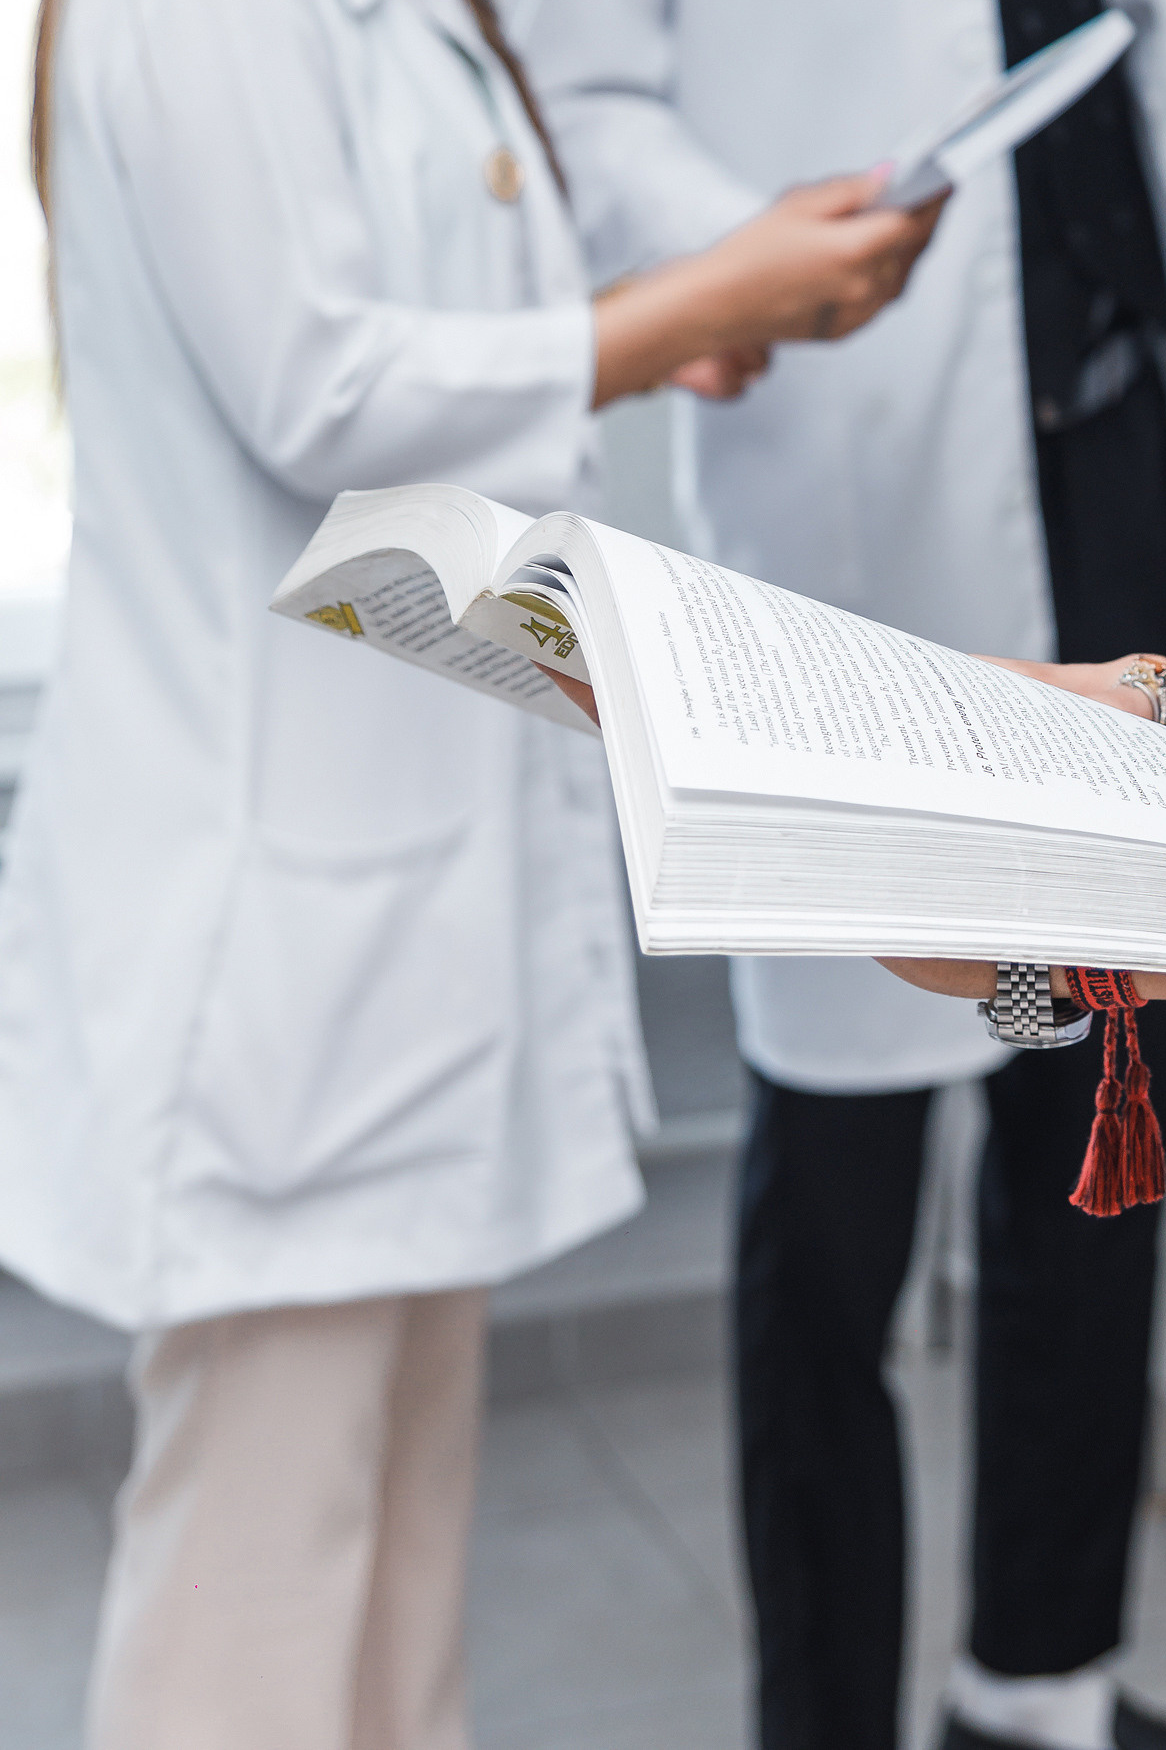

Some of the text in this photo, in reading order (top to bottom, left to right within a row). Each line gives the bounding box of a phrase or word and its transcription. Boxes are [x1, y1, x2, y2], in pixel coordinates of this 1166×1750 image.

[676, 586, 689, 603] from
[694, 595, 704, 606] the
[658, 611, 672, 638] Medicine
[683, 604, 700, 634] suffering
[742, 615, 754, 628] that
[701, 616, 720, 642] present
[732, 619, 745, 640] occurs
[696, 636, 712, 664] persons
[748, 629, 766, 657] anaemia
[666, 639, 684, 677] Community
[728, 648, 738, 661] the
[739, 640, 757, 672] normally
[788, 642, 807, 665] picture
[816, 646, 832, 667] motor
[830, 652, 845, 667] cord
[704, 666, 713, 674] in
[716, 658, 730, 687] vitamin
[733, 663, 741, 671] in
[810, 662, 822, 672] by
[849, 659, 868, 683] picture
[878, 656, 895, 674] given
[676, 678, 686, 686] of
[708, 676, 718, 693] seen
[737, 673, 747, 690] seen
[750, 673, 761, 688] that
[795, 664, 813, 689] clinical
[815, 673, 826, 687] acts
[838, 668, 857, 689] spinal
[725, 689, 735, 701] the
[806, 689, 818, 703] The
[849, 689, 860, 701] the
[891, 680, 904, 695] dose
[680, 688, 696, 719] Principles
[712, 695, 723, 711] also
[728, 703, 739, 713] all
[782, 680, 805, 720] pernicious
[852, 701, 864, 711] of
[885, 694, 901, 720] Vitamin
[899, 696, 913, 714] same
[928, 689, 946, 714] nursing
[746, 709, 760, 731] Lastly
[907, 715, 919, 727] the
[941, 715, 952, 726] are
[952, 698, 972, 726] energy
[733, 715, 749, 745] absorbs
[793, 721, 809, 744] called
[813, 705, 835, 755] Recognition.
[845, 715, 861, 743] sensory
[859, 713, 882, 761] degeneration
[947, 727, 959, 742] who
[1008, 725, 1022, 741] They
[785, 741, 797, 751] of
[880, 733, 892, 748] The
[898, 724, 919, 765] Treatment.
[967, 728, 988, 760] Protein
[985, 728, 1001, 750] energy
[999, 737, 1012, 747] of
[839, 748, 851, 758] of
[855, 745, 867, 759] like
[911, 729, 935, 768] Afterwards
[934, 727, 957, 771] Prevention.
[954, 744, 973, 774] mothers
[1007, 747, 1029, 783] conditions
[1037, 756, 1052, 773] They
[999, 762, 1015, 780] PEM
[1029, 771, 1044, 785] and
